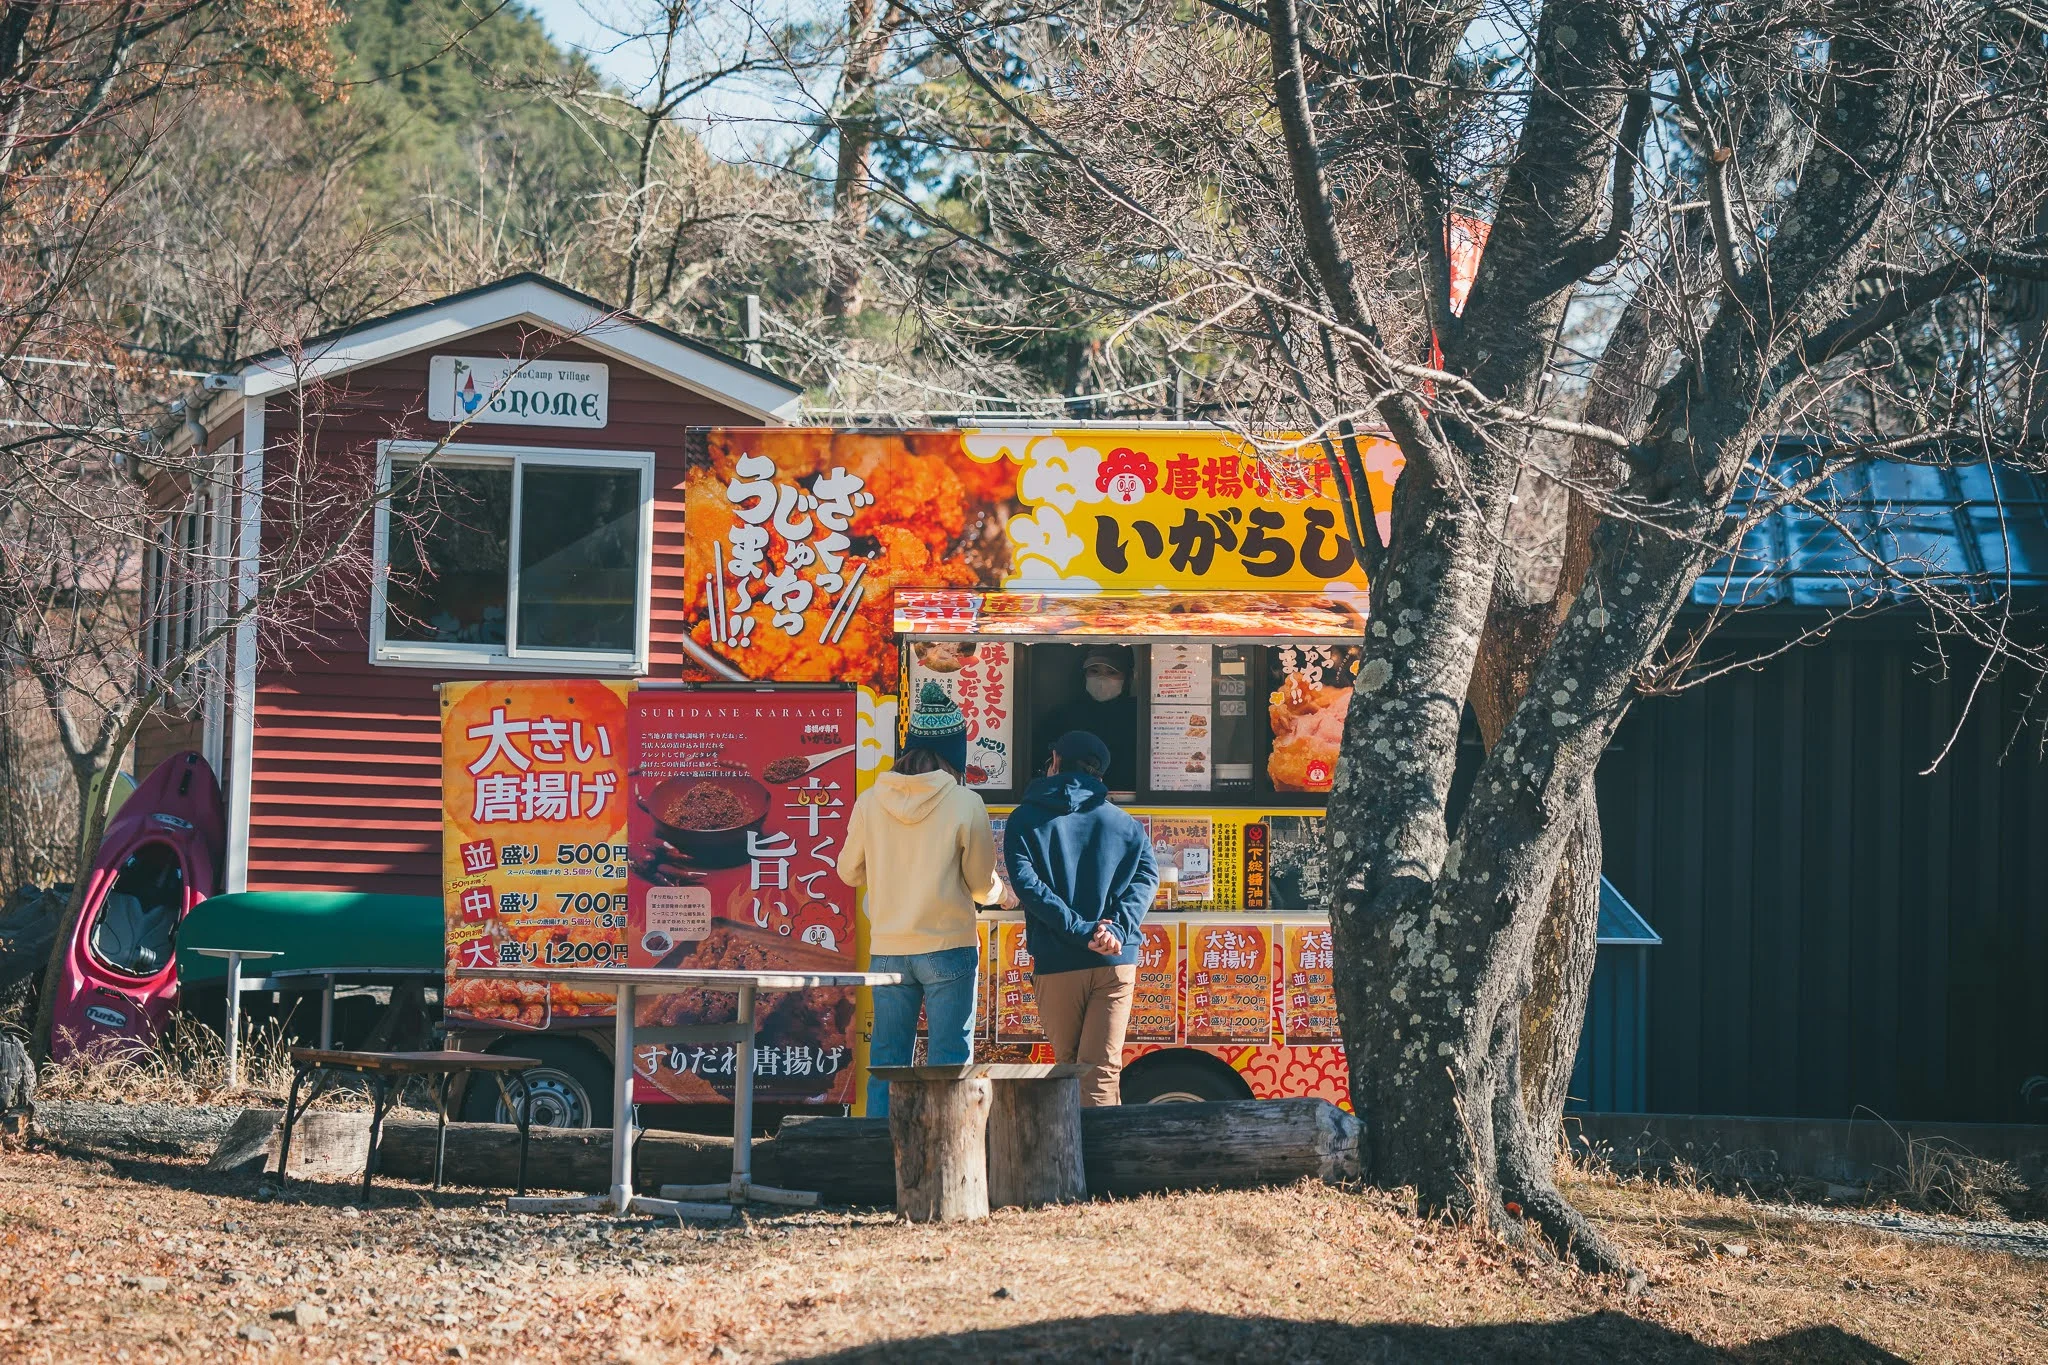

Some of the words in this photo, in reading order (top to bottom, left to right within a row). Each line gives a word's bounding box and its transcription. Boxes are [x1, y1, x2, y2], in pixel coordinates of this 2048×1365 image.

[558, 370, 591, 382] Village
[489, 389, 601, 421] GNOME
[812, 466, 875, 593] ざくっ
[1094, 507, 1357, 579] いがらし
[763, 483, 819, 636] じゅわっ
[980, 642, 1010, 730] 味しさへの
[467, 707, 613, 775] 大きい
[472, 772, 618, 822] 唐揚げ
[464, 842, 496, 872] 並
[501, 844, 539, 866] 盛り
[557, 843, 629, 865] 500円
[746, 830, 798, 937] 旨い。
[464, 890, 492, 919] 中
[499, 893, 539, 914] 盛り
[556, 892, 629, 913] 700円
[1205, 930, 1256, 950] 大きい
[464, 940, 494, 968] 大
[499, 942, 538, 963] 盛り
[1202, 950, 1260, 970] 唐揚げ
[1140, 973, 1172, 982] 500円
[1196, 972, 1210, 986] 並
[1211, 974, 1228, 984] 盛り
[1235, 974, 1267, 984] 500円
[1293, 973, 1307, 986] 並
[1308, 974, 1326, 984] 盛り
[1007, 992, 1019, 1005] 中
[1140, 994, 1171, 1004] 700円
[1196, 994, 1208, 1007] 中
[1211, 996, 1228, 1005] 盛り
[1236, 996, 1266, 1005] 700円
[1294, 994, 1306, 1007] 中
[1309, 995, 1326, 1005] 盛り
[1007, 1013, 1019, 1027] 大
[1195, 1016, 1209, 1028] 大
[1210, 1017, 1227, 1026] 盛り
[1293, 1016, 1308, 1030] 大
